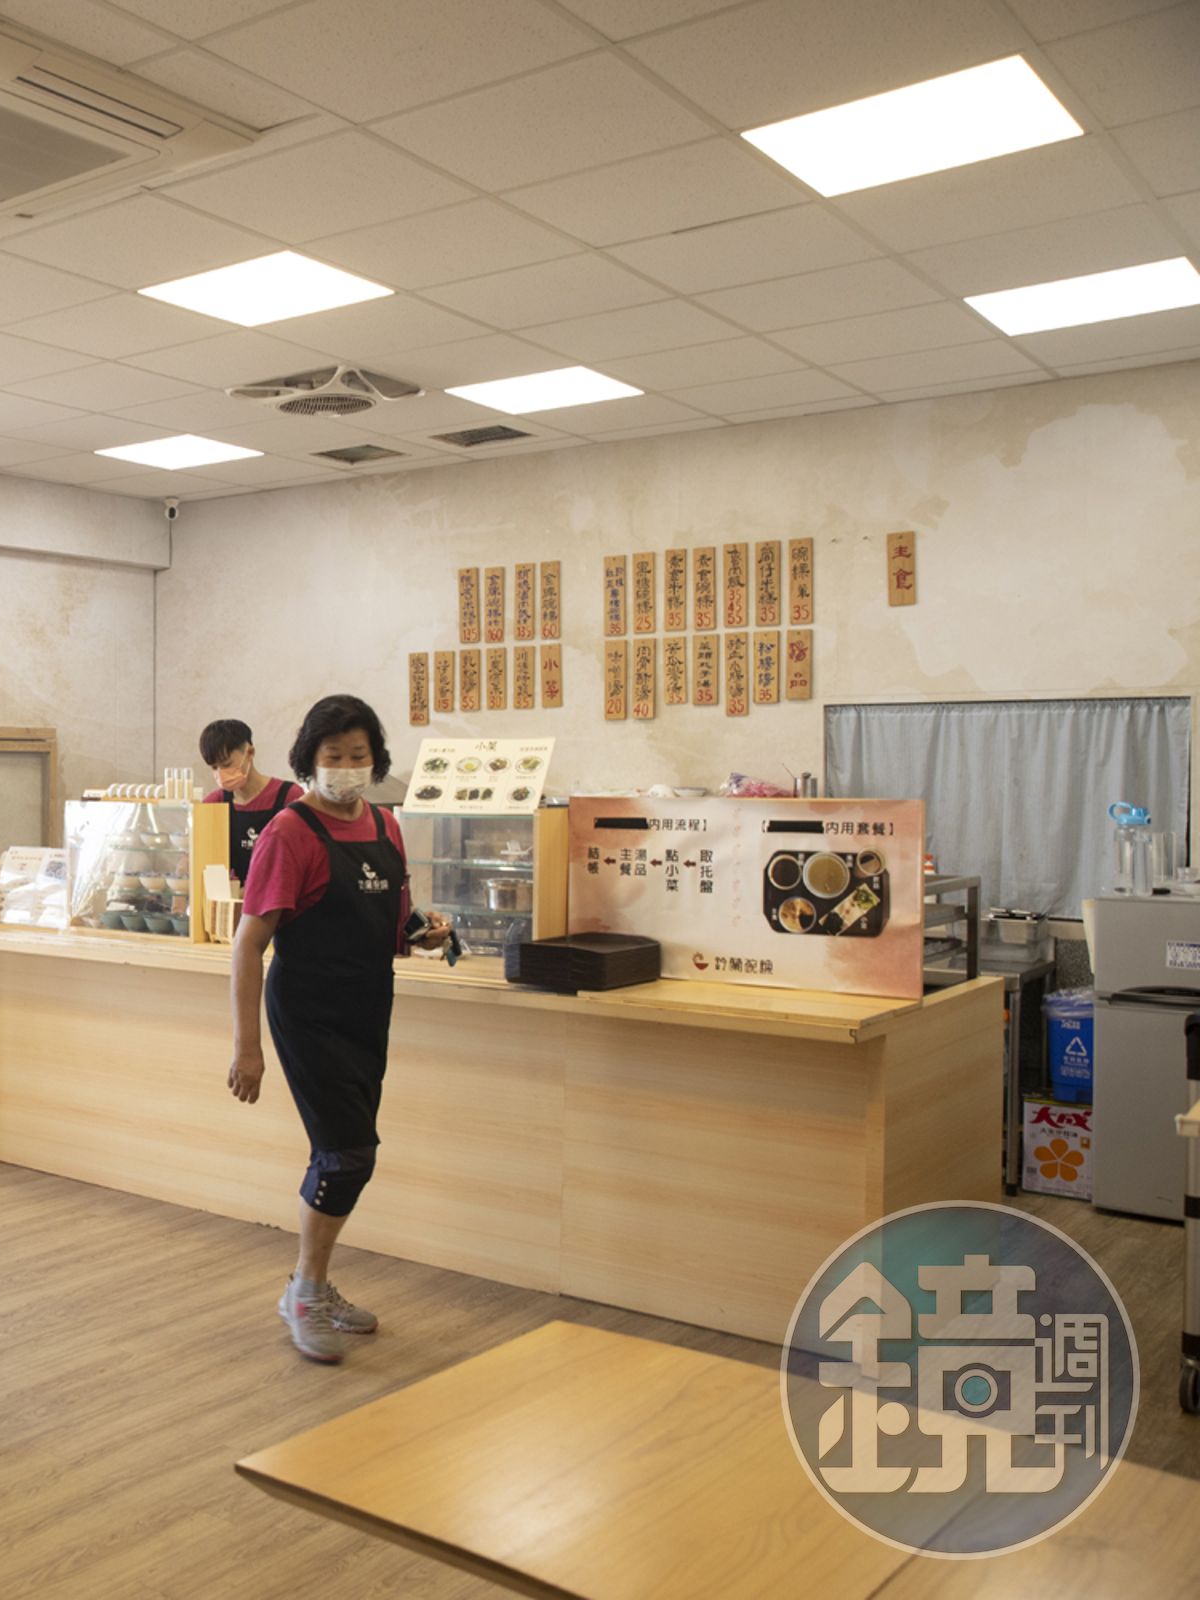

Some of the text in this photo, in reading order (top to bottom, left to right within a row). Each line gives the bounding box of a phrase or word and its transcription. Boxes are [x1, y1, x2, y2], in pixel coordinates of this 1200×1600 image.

[758, 546, 778, 604] 筒仔米糕
[892, 545, 912, 590] 主食
[668, 612, 682, 626] 35
[696, 612, 711, 627] 35
[728, 613, 742, 624] 55
[760, 607, 776, 622] 35
[792, 604, 810, 620] 35
[543, 623, 557, 637] 60
[637, 615, 651, 630] 25
[789, 640, 808, 688] 湯品
[543, 658, 559, 700] 小菜
[696, 689, 712, 701] 35
[760, 689, 772, 701] 35
[438, 699, 449, 710] 15
[607, 699, 622, 715] 20
[633, 703, 649, 717] 40
[729, 699, 744, 714] 35
[587, 847, 600, 875] 結帳
[619, 848, 632, 876] 主餐
[635, 849, 647, 876] 湯品
[665, 849, 679, 892] 點小菜
[700, 850, 713, 893] 取托盤
[1029, 1105, 1093, 1132] 大成
